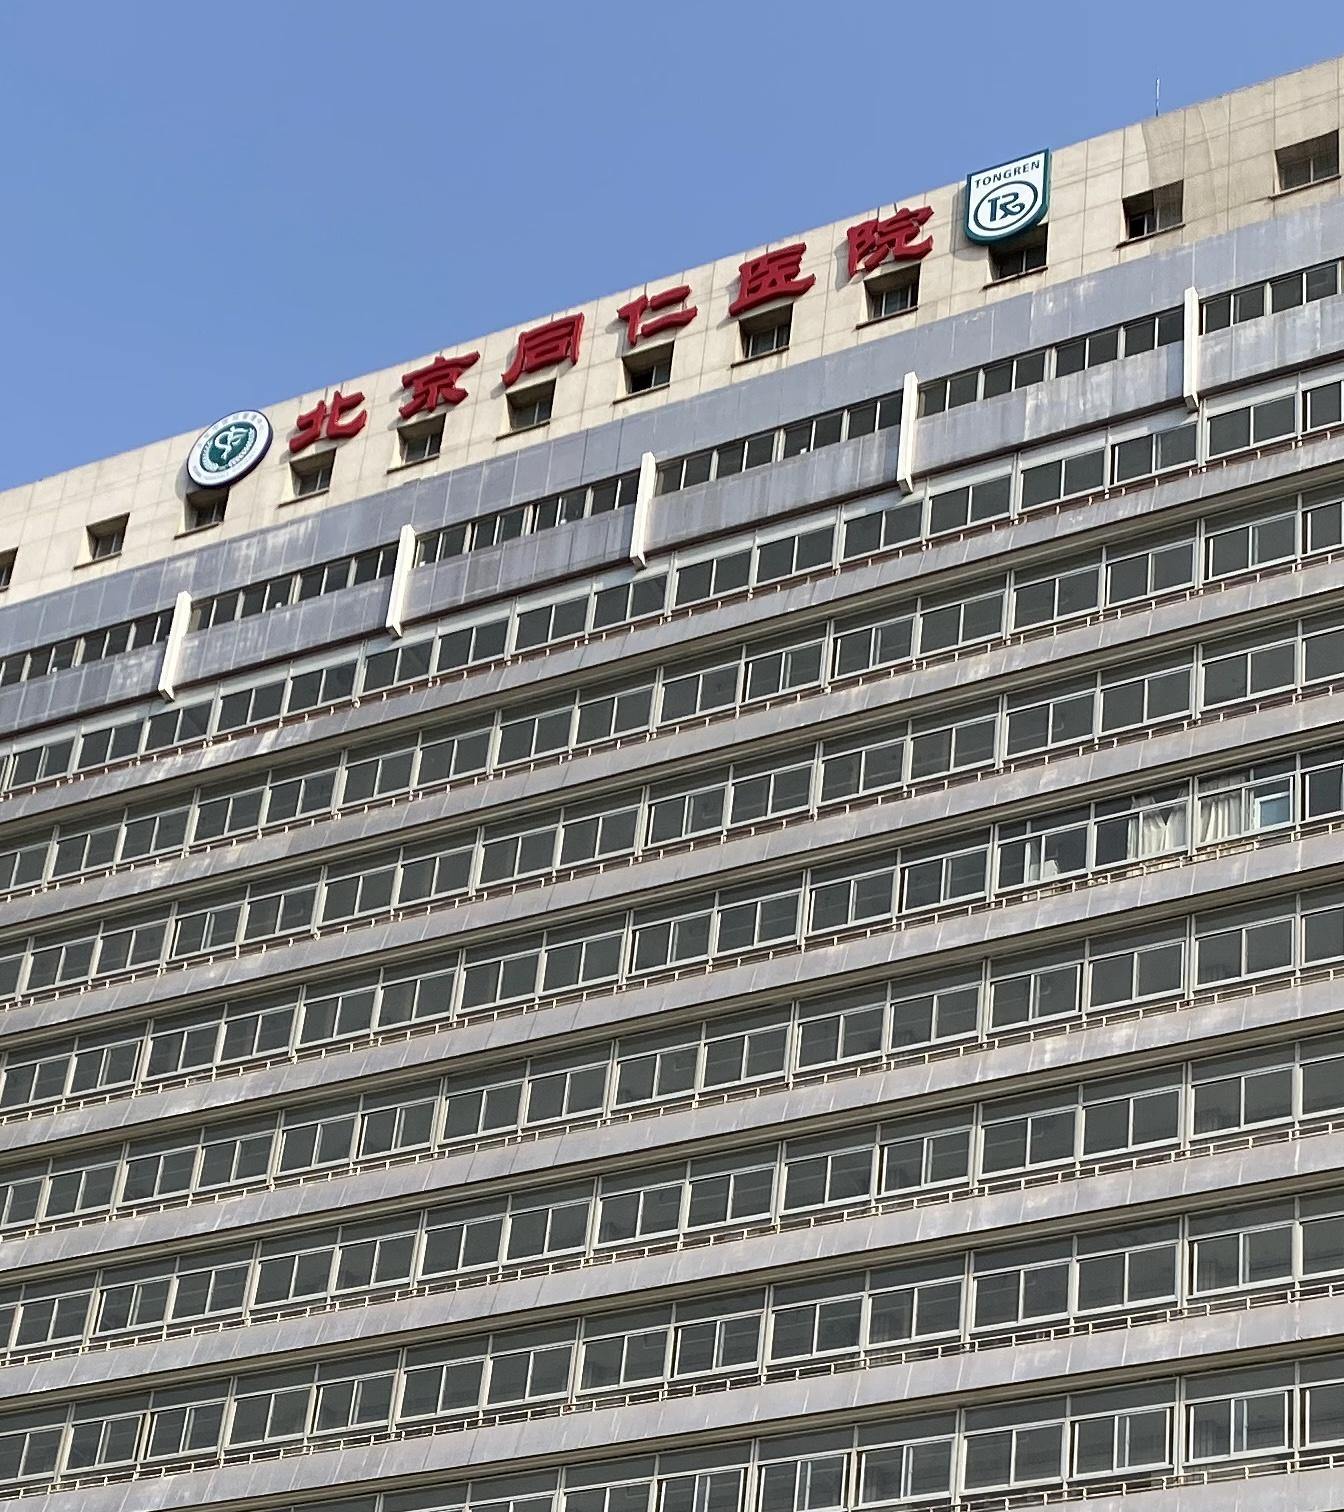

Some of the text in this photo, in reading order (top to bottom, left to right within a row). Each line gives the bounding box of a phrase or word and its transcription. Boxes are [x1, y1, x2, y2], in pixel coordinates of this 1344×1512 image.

[974, 160, 1040, 189] TONGREN
[289, 206, 935, 453] 北京同仁医院
